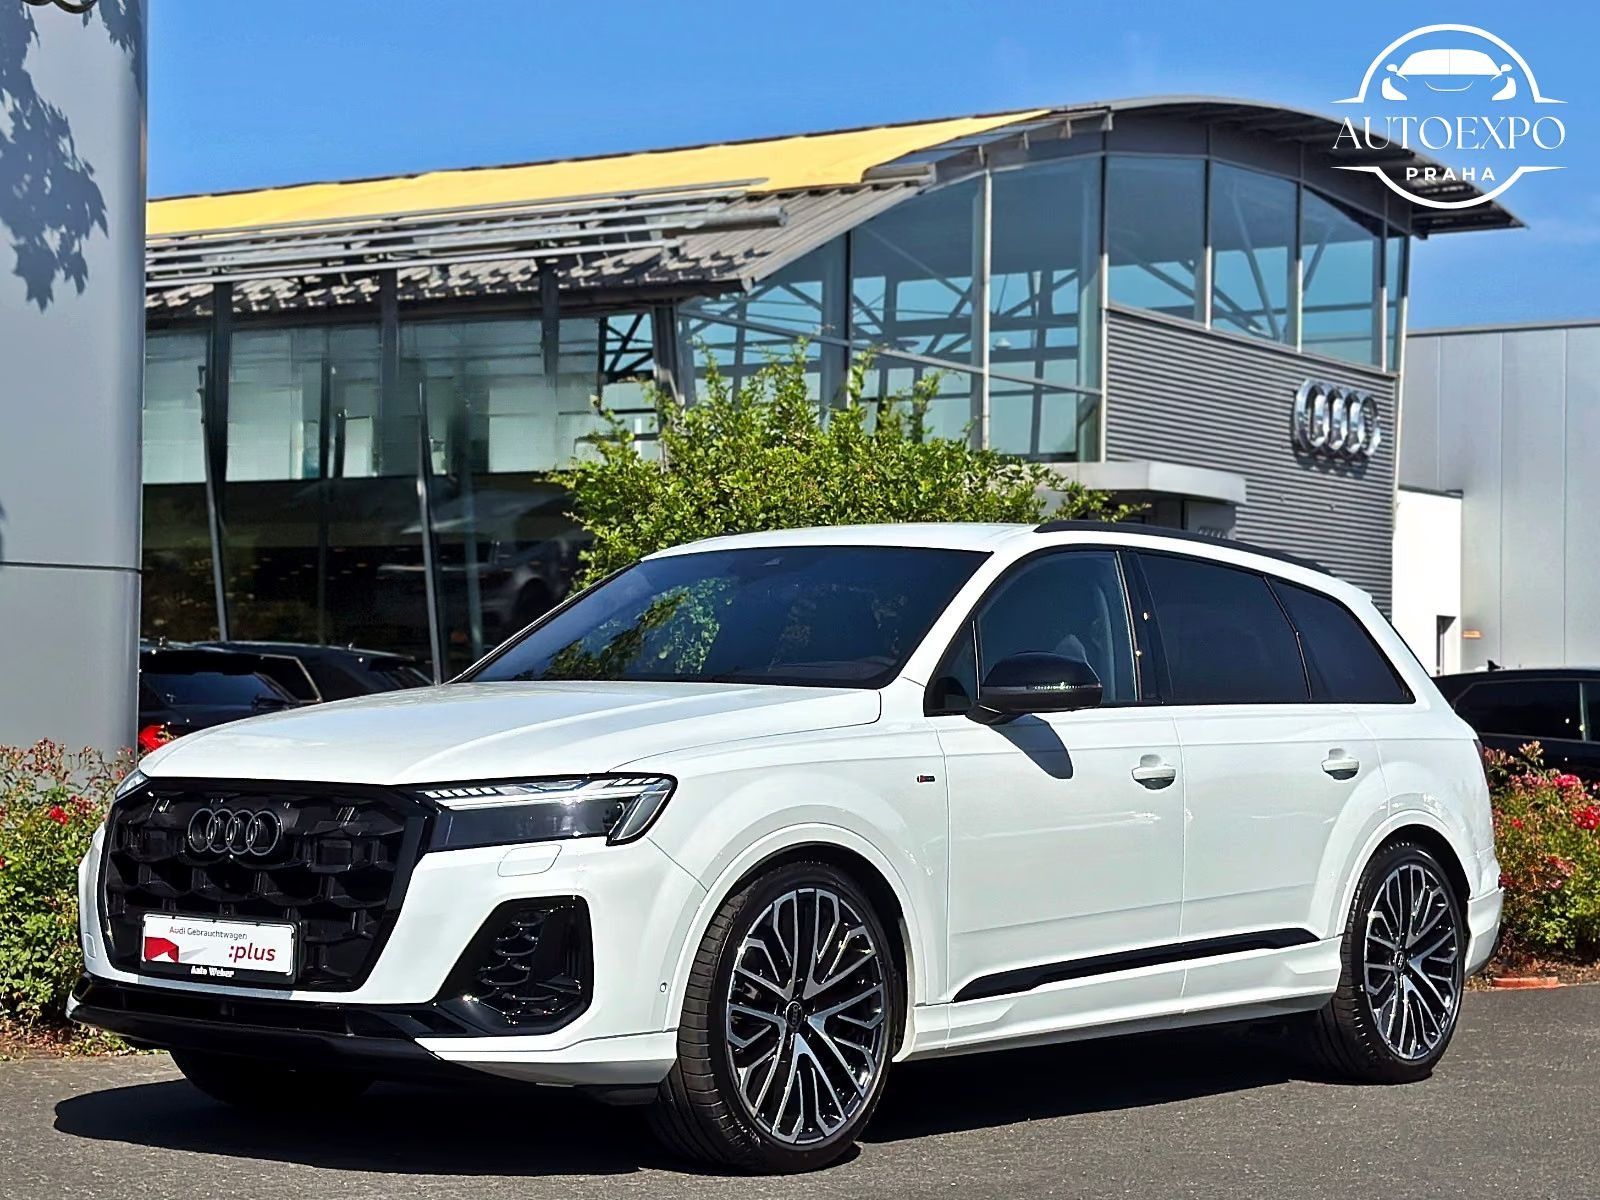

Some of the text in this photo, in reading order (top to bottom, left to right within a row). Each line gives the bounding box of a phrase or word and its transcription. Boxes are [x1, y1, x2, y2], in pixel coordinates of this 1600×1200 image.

[169, 926, 248, 941] Audi Gebrauchtwagen
[228, 942, 276, 963] :plus
